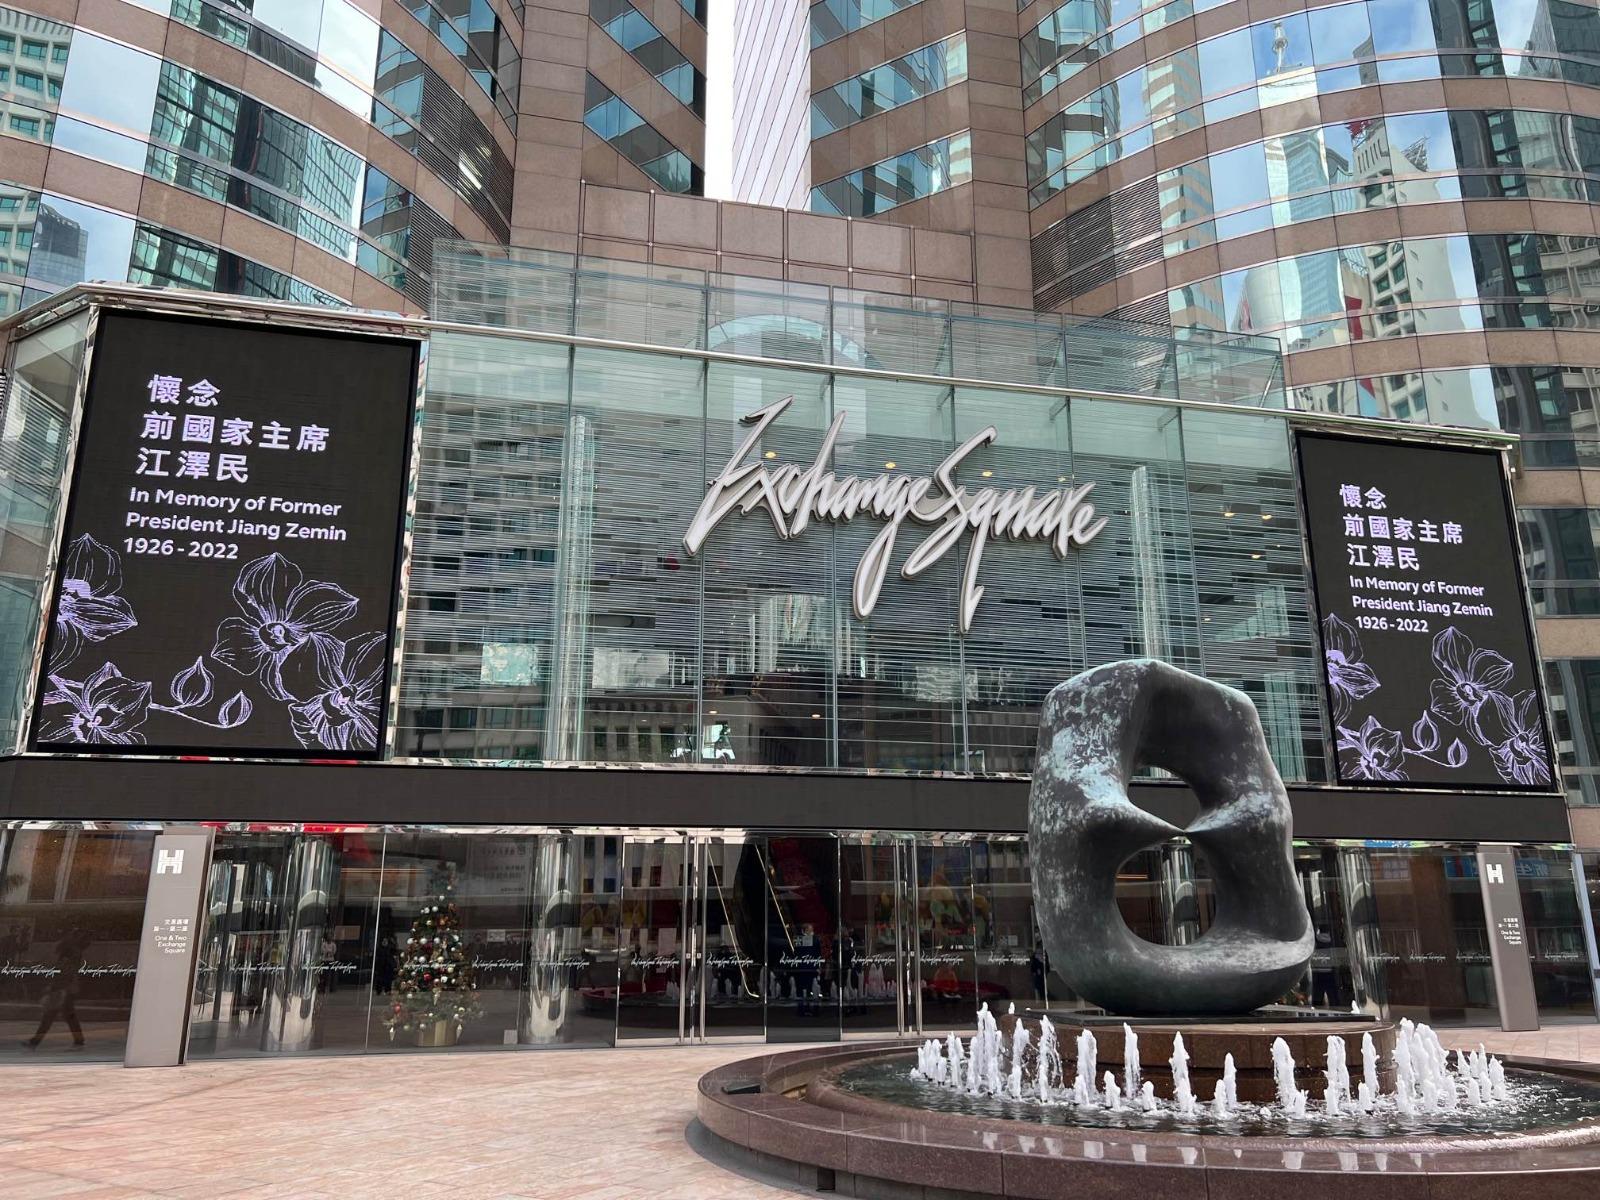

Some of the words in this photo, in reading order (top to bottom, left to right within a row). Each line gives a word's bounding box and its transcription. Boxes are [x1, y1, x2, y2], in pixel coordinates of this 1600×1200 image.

[147, 374, 221, 407] 懷念
[140, 410, 330, 452] 前國家主席
[135, 446, 249, 483] 江澤民
[129, 487, 150, 502] In
[155, 488, 240, 513] Memory
[244, 496, 266, 511] of
[269, 497, 342, 516] Former
[1339, 483, 1387, 510] 懷念
[125, 512, 225, 534] President
[227, 519, 280, 540] Jiang
[284, 522, 347, 541] Zemin
[682, 394, 952, 620] Exchange
[900, 425, 1109, 635] Square
[1342, 513, 1463, 545] 前國家主席
[123, 537, 174, 556] 1926
[188, 541, 239, 559] 2022
[1346, 543, 1420, 571] 江澤民
[1349, 575, 1363, 588] In
[1365, 576, 1419, 595] Memory
[1422, 581, 1436, 593] of
[1437, 581, 1485, 596] Former
[1352, 595, 1414, 611] President
[1416, 600, 1451, 616] Jiang
[1452, 602, 1493, 617] Zemin
[1355, 616, 1388, 630] 1926
[1397, 618, 1429, 632] 2022
